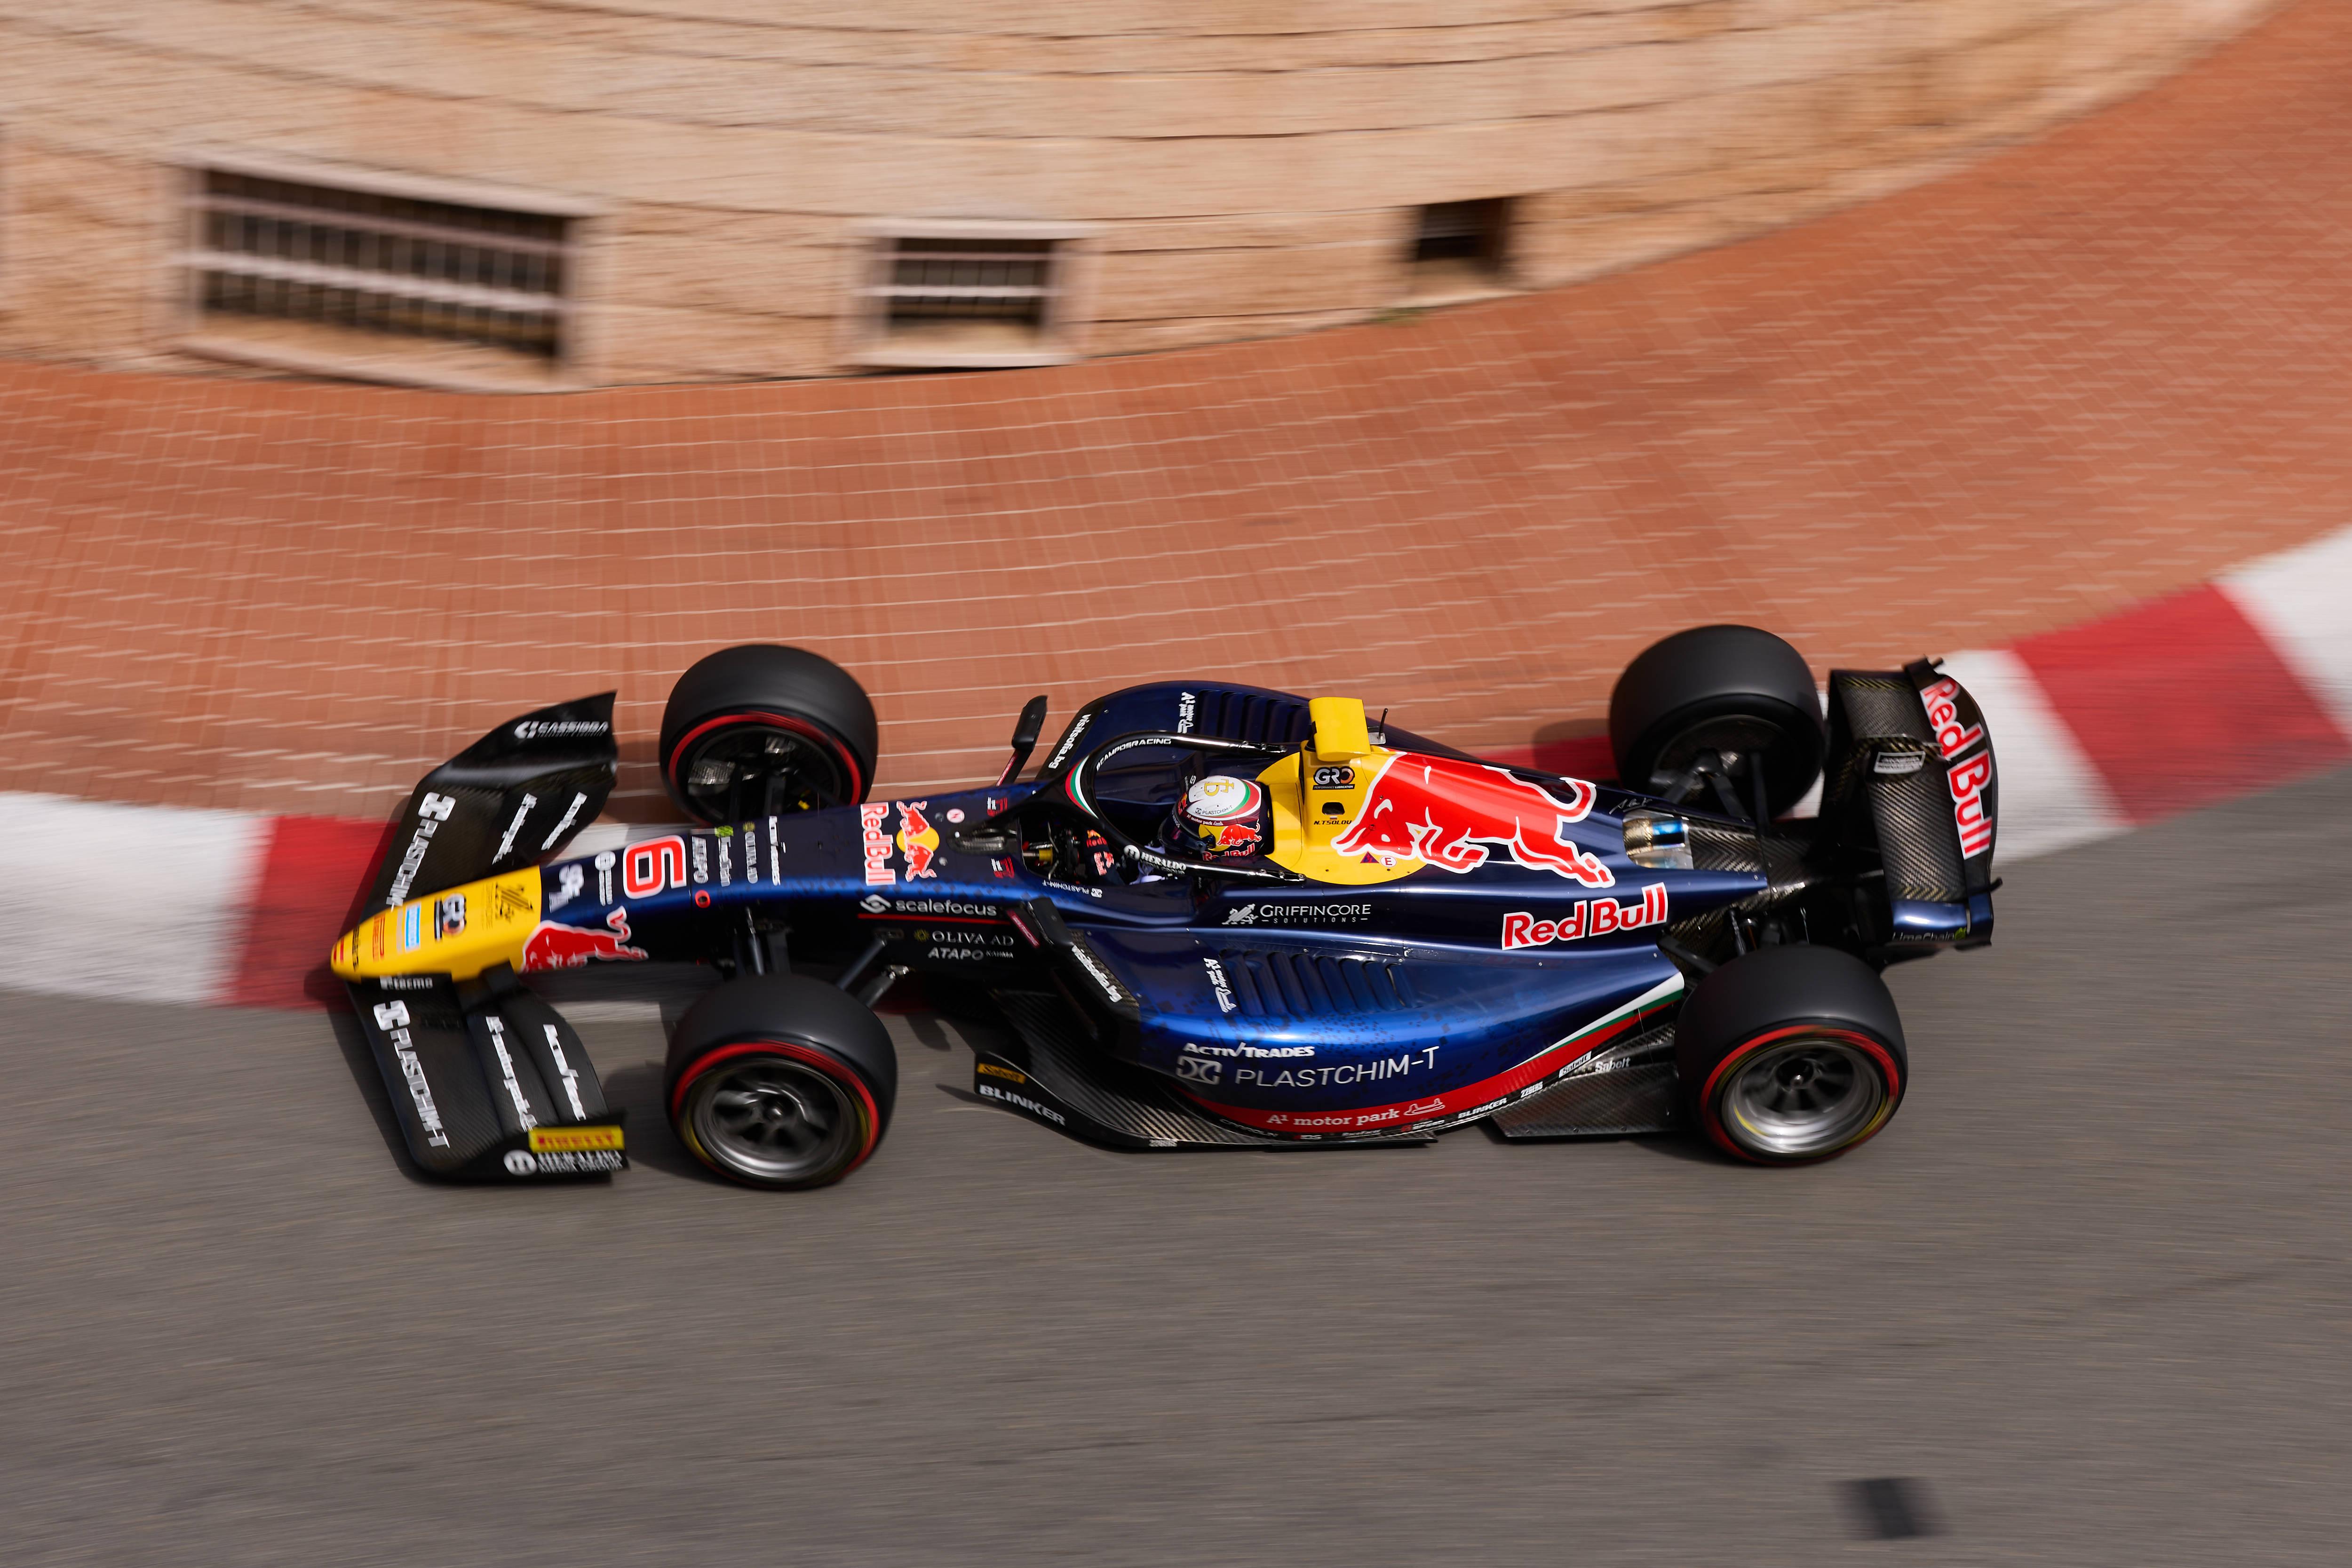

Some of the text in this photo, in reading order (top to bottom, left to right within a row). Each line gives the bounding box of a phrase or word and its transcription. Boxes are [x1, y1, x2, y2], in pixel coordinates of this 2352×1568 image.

[1049, 714, 1091, 769] visitsofia.bg
[1314, 767, 1354, 785] GRO
[1919, 676, 1993, 860] Red Bull
[1202, 805, 1233, 815] PLASTCHIM-T
[861, 803, 896, 886] Red Bull
[623, 835, 687, 899] 6
[1141, 852, 1187, 871] HERALDO
[1384, 857, 1393, 866] E
[896, 899, 997, 916] scalefocus
[1502, 882, 1669, 950] Red Bull
[932, 930, 1014, 947] OLIVA AD
[1235, 1046, 1440, 1088] PLASTCHIM-T
[1595, 1057, 1631, 1073] Sabelt
[980, 1084, 1066, 1127] BLINKER
[1458, 1097, 1507, 1119] BLINKER
[1293, 1116, 1353, 1126] motor
[1356, 1108, 1400, 1126] park
